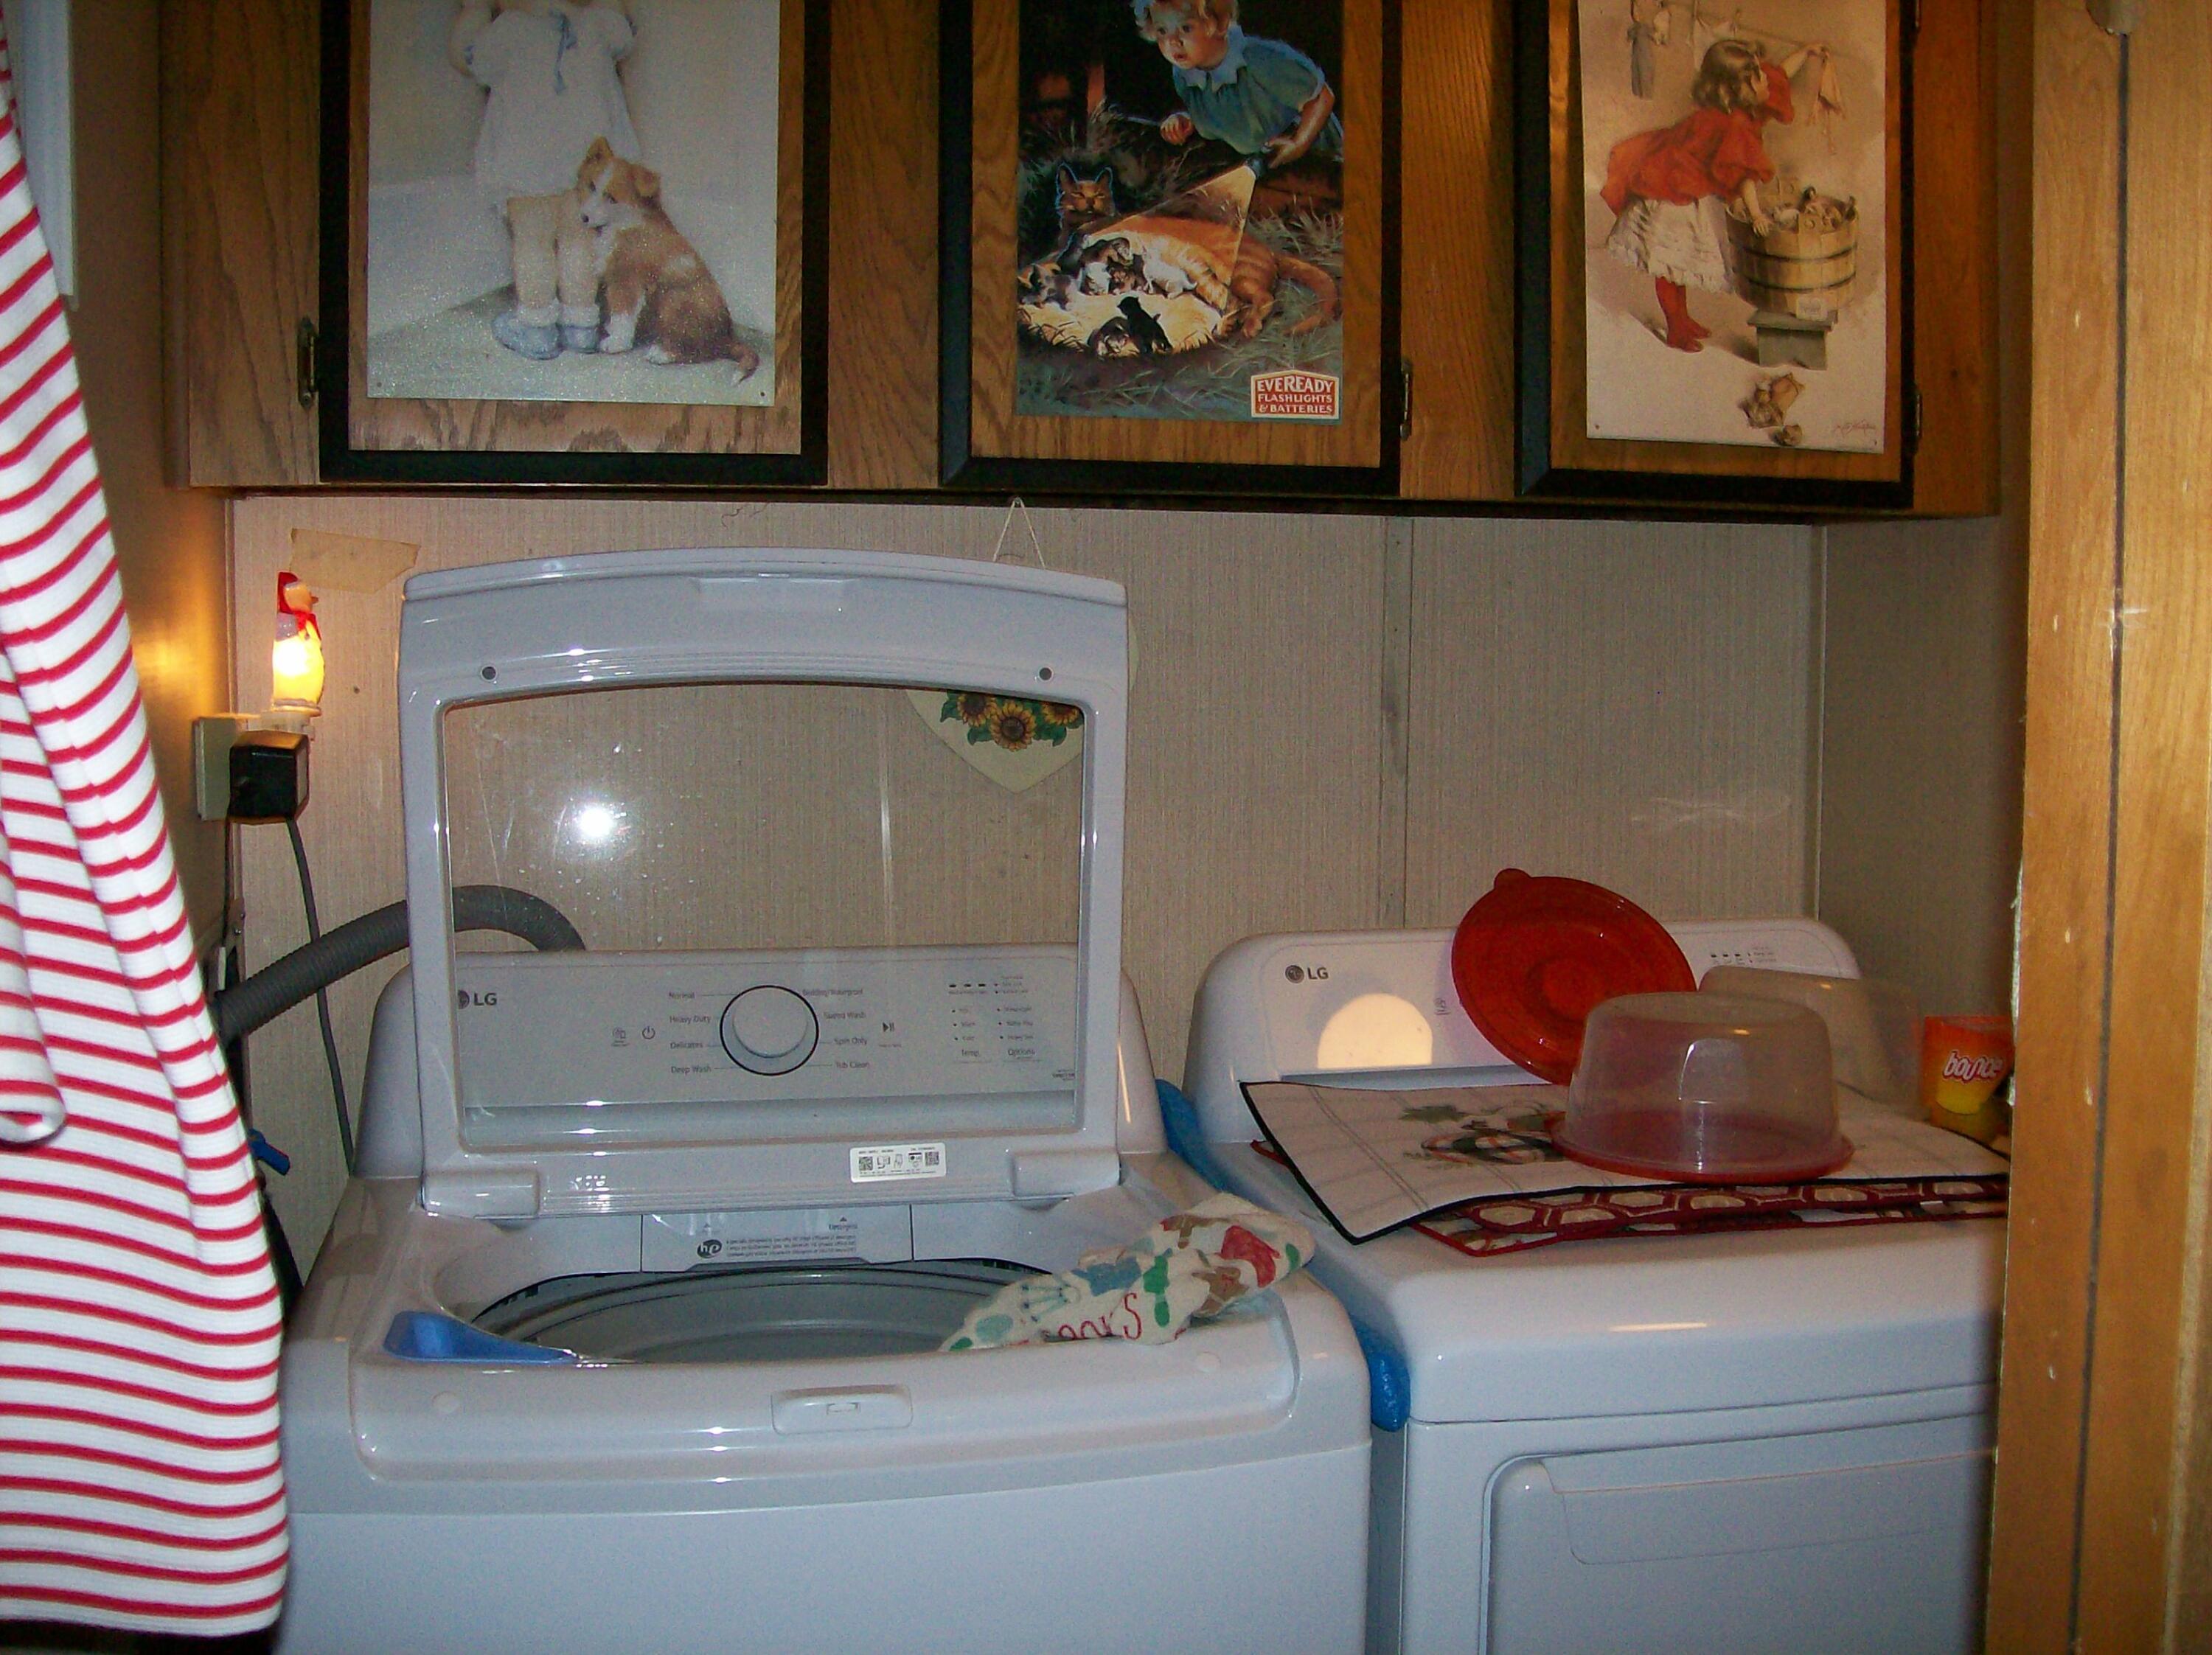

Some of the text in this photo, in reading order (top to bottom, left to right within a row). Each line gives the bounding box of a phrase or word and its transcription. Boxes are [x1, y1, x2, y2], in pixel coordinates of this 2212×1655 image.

[1256, 375, 1334, 393] EVEREADY
[1257, 394, 1333, 403] FLASHLIGHTS
[1259, 404, 1333, 414] & BATTERIES
[1307, 966, 1329, 980] LG
[473, 992, 498, 1006] LG
[669, 1014, 712, 1024] Heavy Duty
[851, 1036, 868, 1045] Only
[669, 1042, 703, 1050] Delicates
[671, 1066, 690, 1075] Deep
